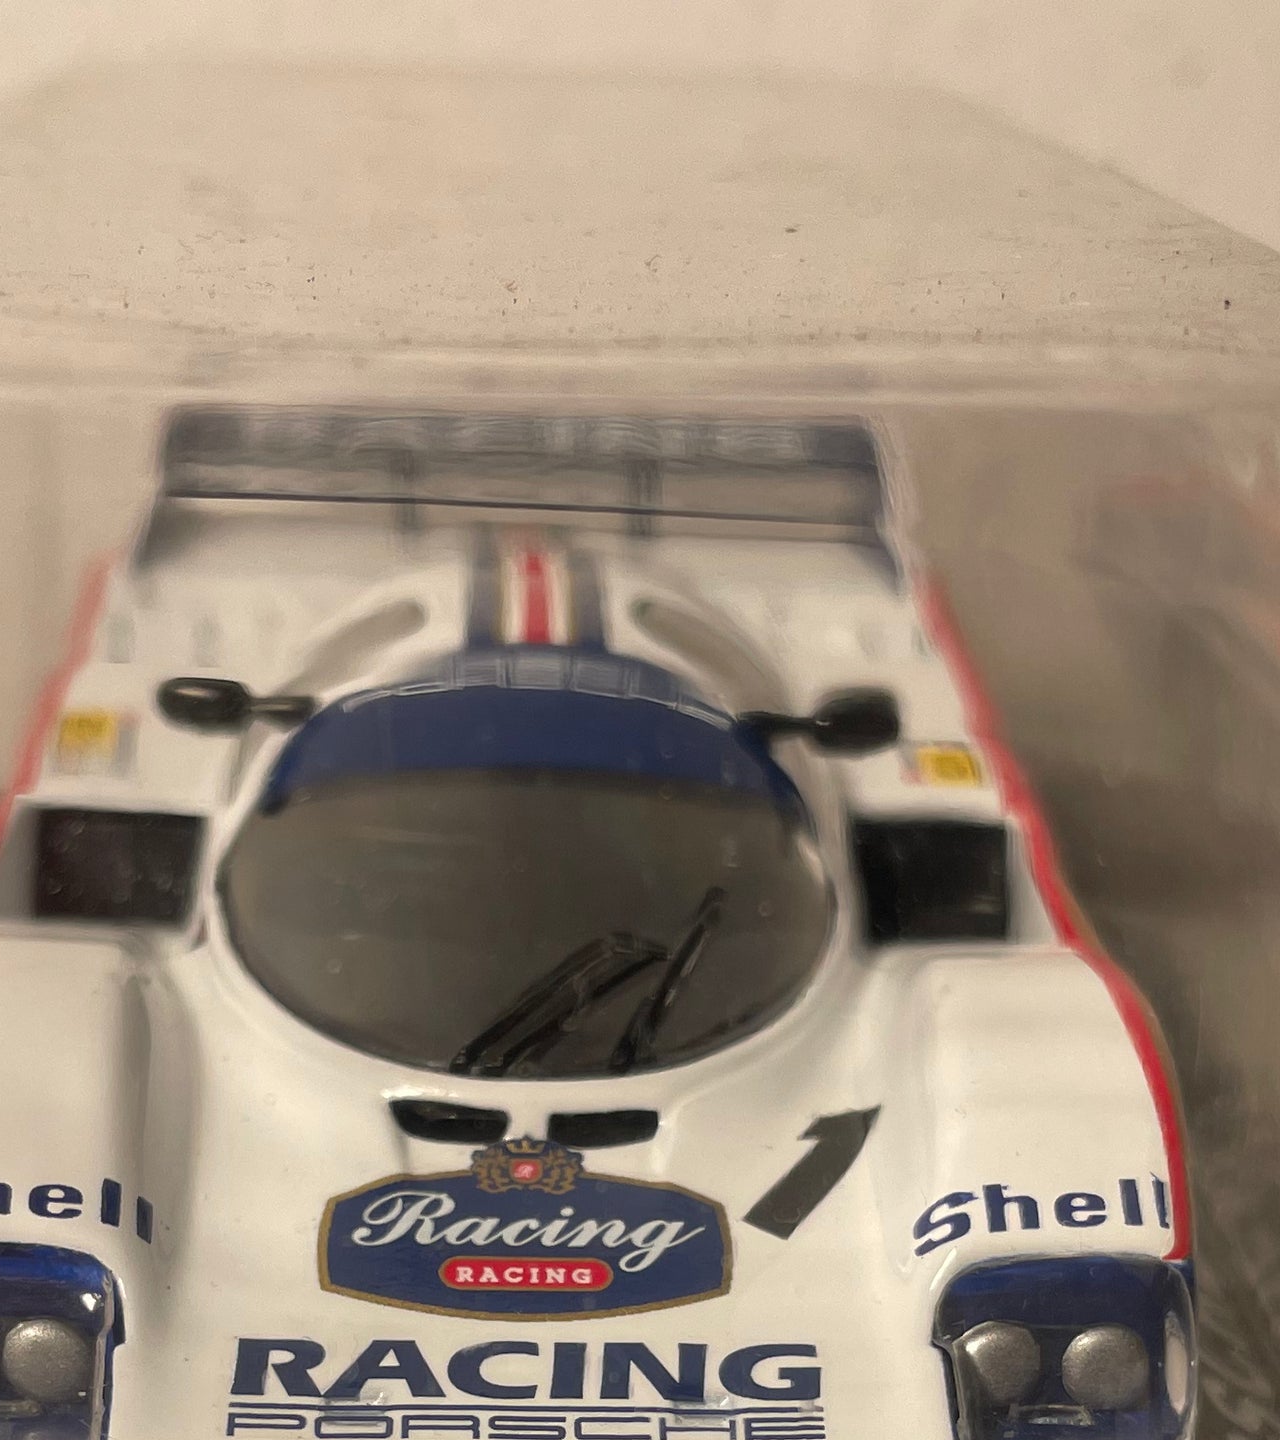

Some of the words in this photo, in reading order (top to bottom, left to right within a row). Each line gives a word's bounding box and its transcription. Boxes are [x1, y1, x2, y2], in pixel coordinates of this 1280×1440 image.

[740, 1105, 882, 1240] 1
[350, 1191, 706, 1272] Racing
[913, 1171, 1171, 1257] Shell
[455, 1265, 593, 1286] RACING
[229, 1337, 823, 1402] RACING
[225, 1412, 827, 1440] PORSCHE
